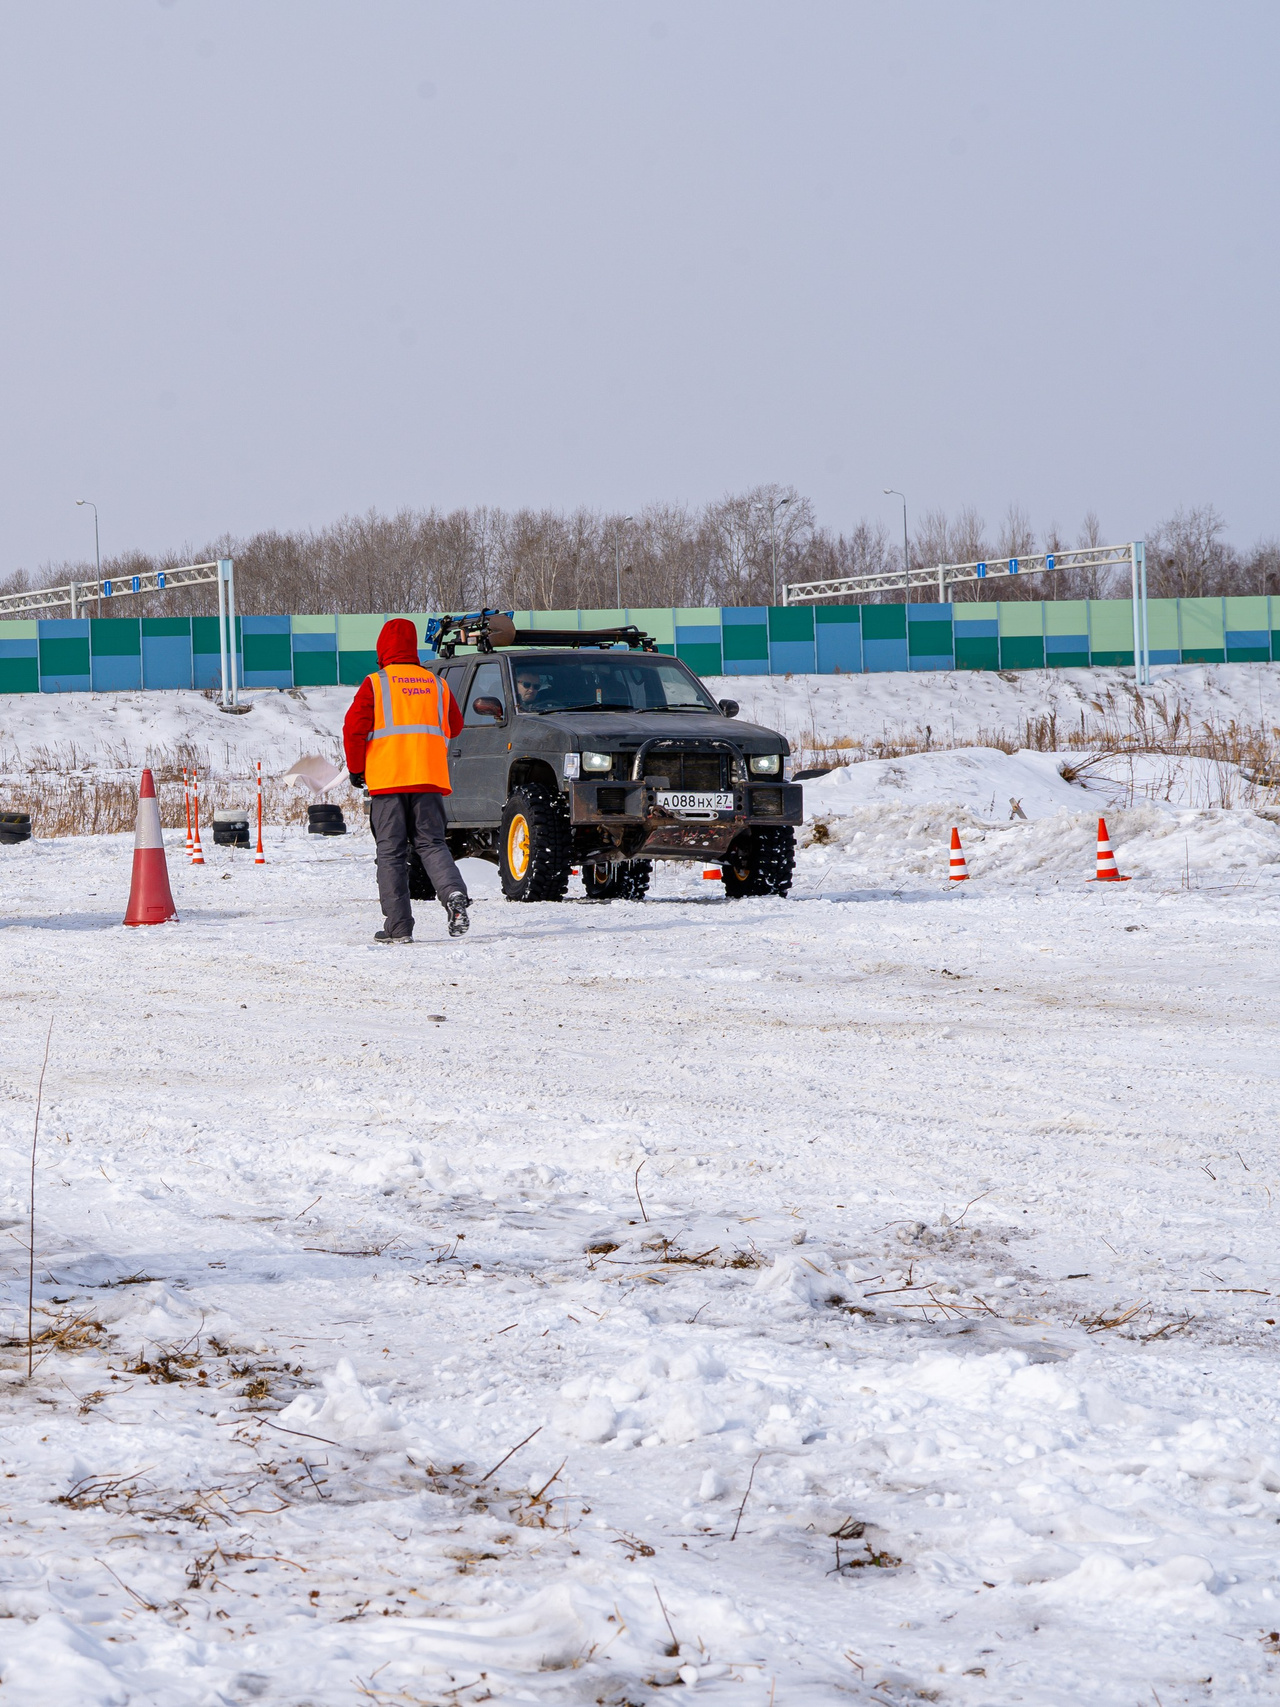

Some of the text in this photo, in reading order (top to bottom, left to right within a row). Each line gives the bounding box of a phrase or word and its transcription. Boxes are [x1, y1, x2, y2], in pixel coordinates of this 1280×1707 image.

[391, 675, 435, 684] Главный
[401, 687, 431, 696] судья
[716, 795, 729, 804] 27
